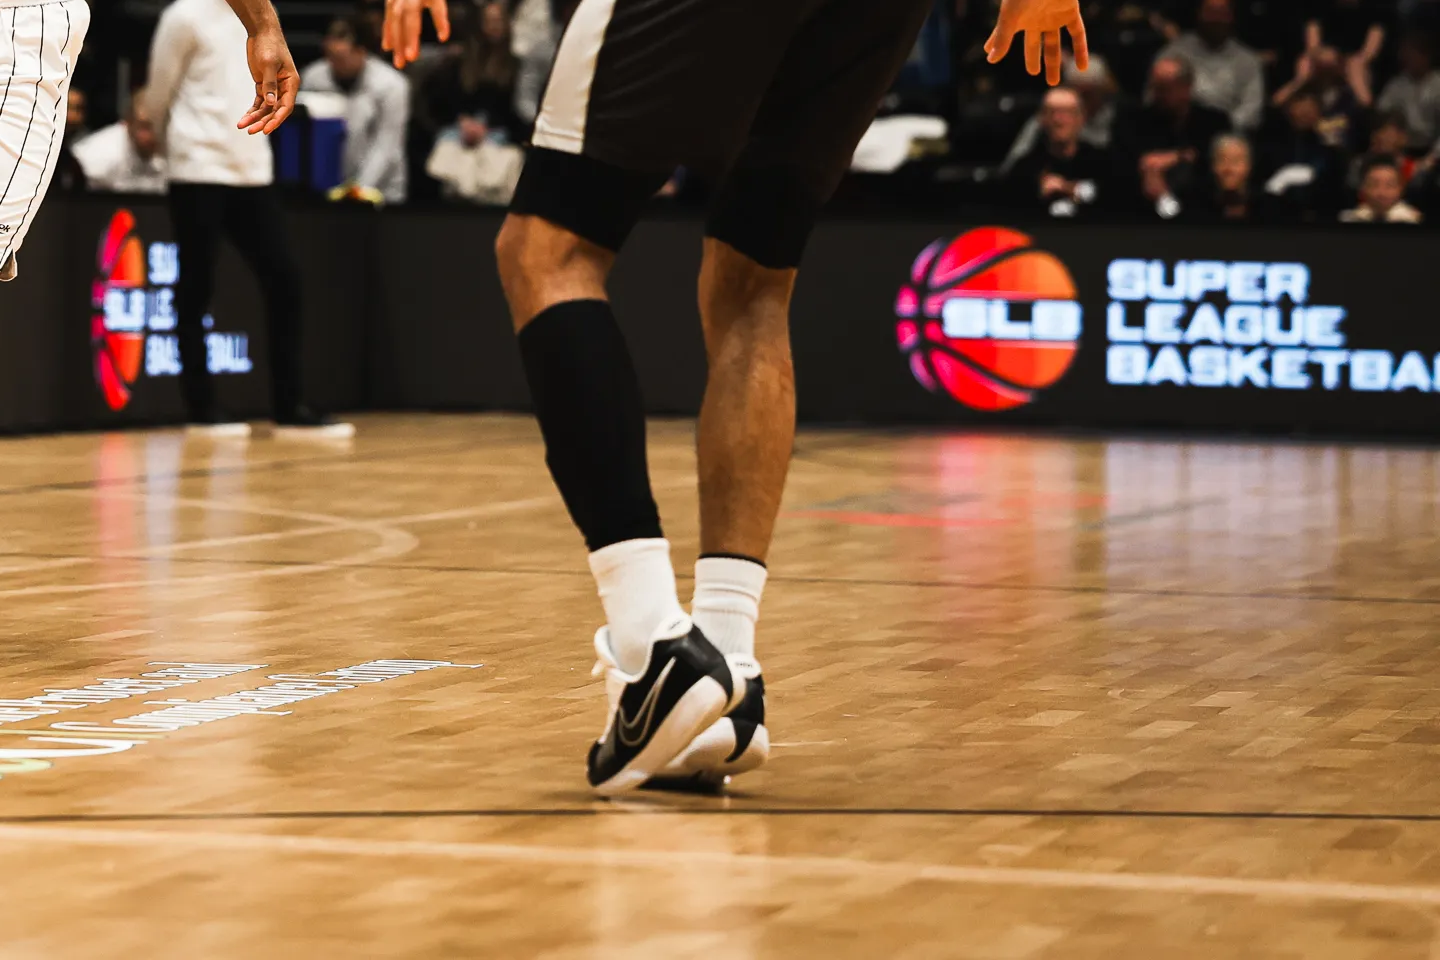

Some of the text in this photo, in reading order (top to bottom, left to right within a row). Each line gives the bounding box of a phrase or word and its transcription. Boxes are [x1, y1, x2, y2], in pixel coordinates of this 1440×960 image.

[1106, 258, 1310, 303] SUPER
[942, 297, 1083, 340] SLB
[1106, 302, 1346, 347] LEAGUE
[1106, 344, 1440, 392] BASKETBA
[140, 662, 270, 679] and
[50, 659, 484, 733] Compliance Group
